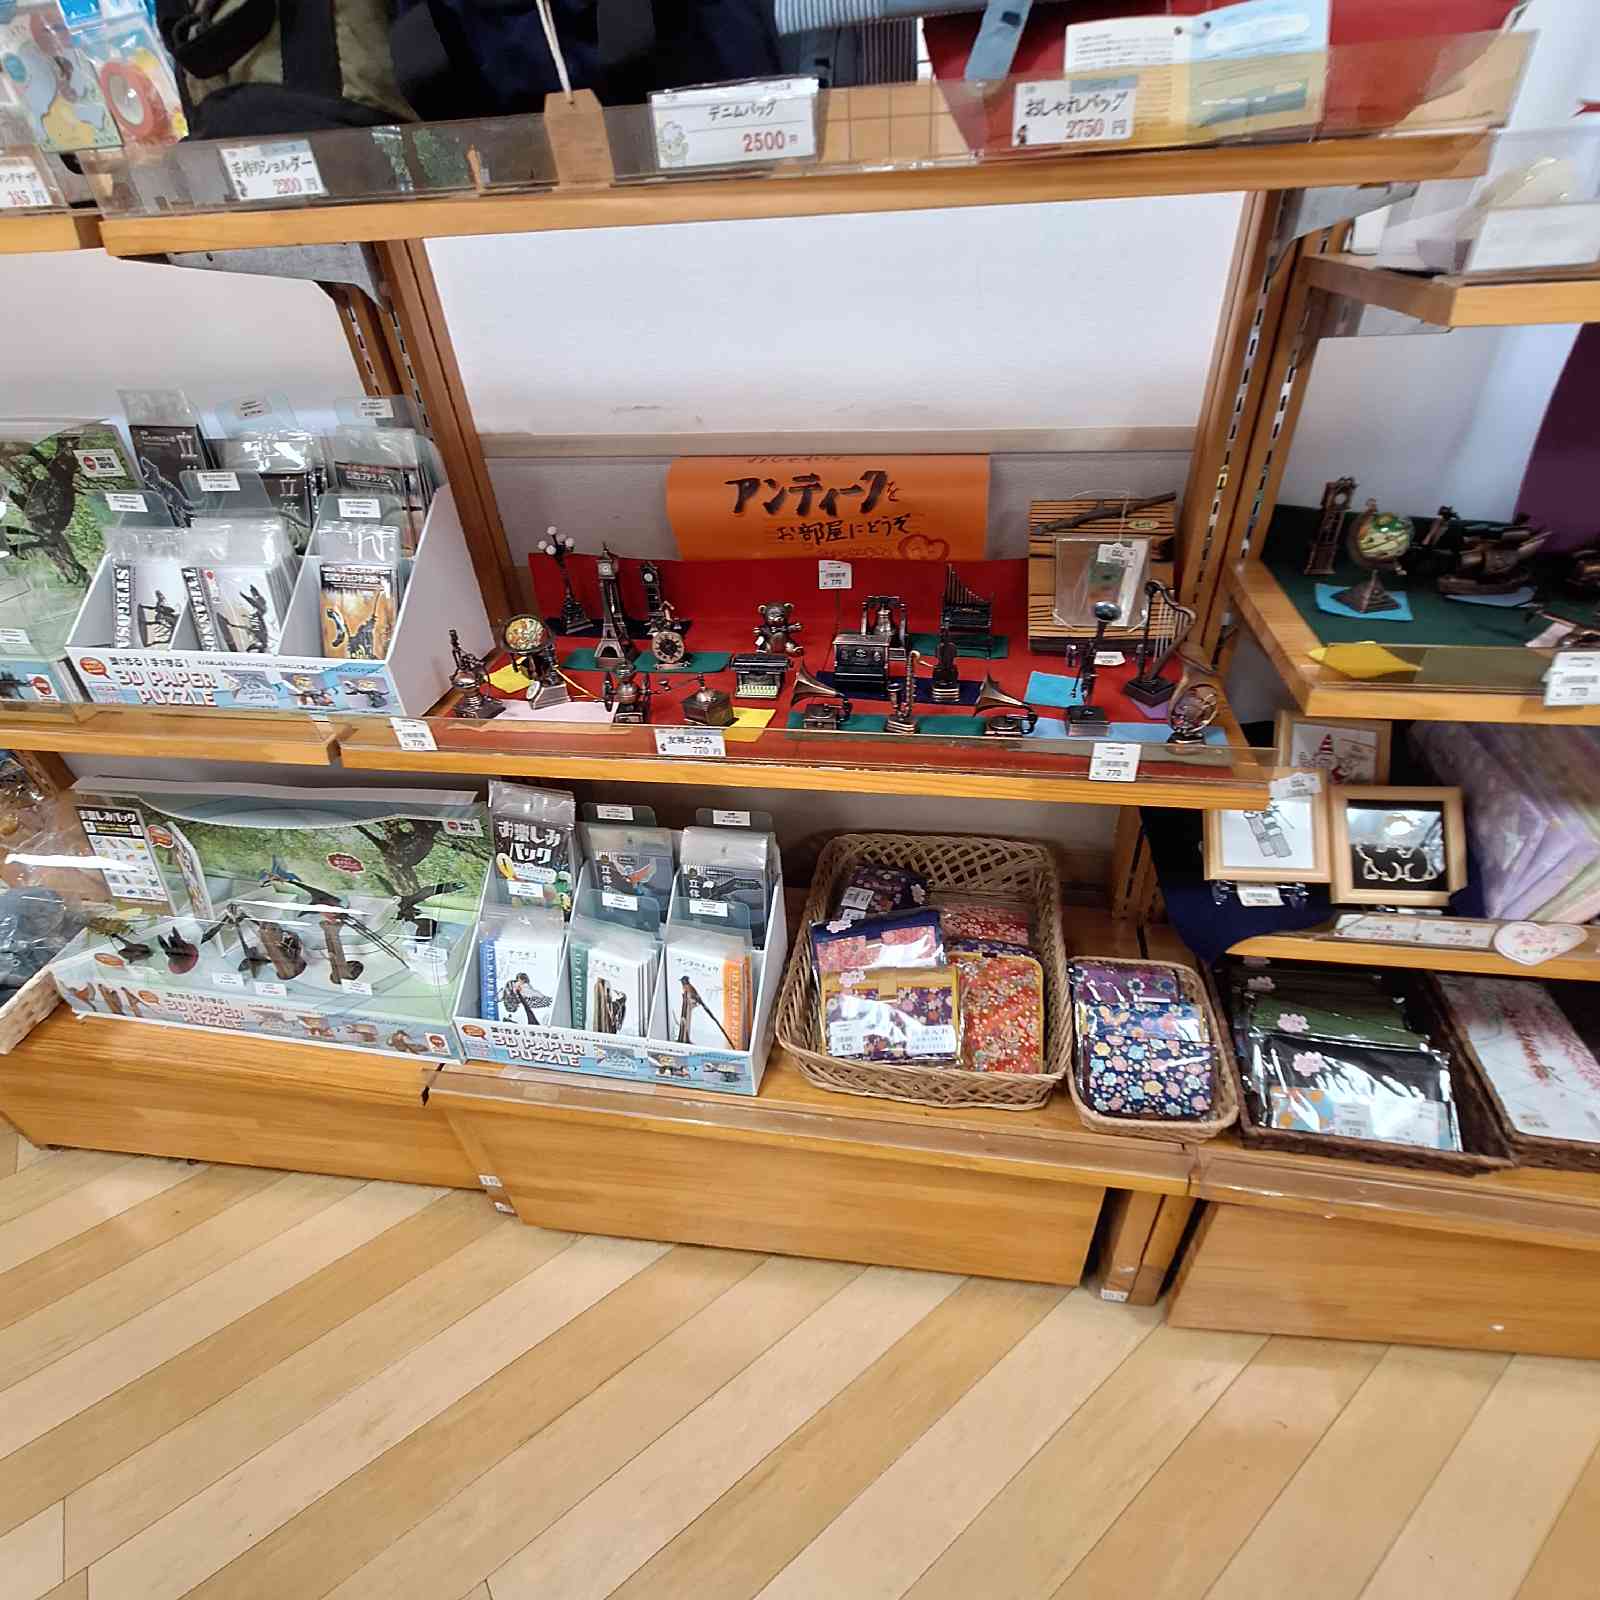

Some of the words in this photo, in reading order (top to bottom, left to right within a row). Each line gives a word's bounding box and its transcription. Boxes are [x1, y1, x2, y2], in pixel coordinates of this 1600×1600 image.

[743, 130, 785, 153] 2500
[775, 512, 912, 546] お部屋にどうぞ
[150, 671, 218, 689] PAPER
[138, 689, 218, 708] PUZZLE
[521, 1037, 586, 1055] PAPER
[508, 1047, 581, 1068] PUZZLE
